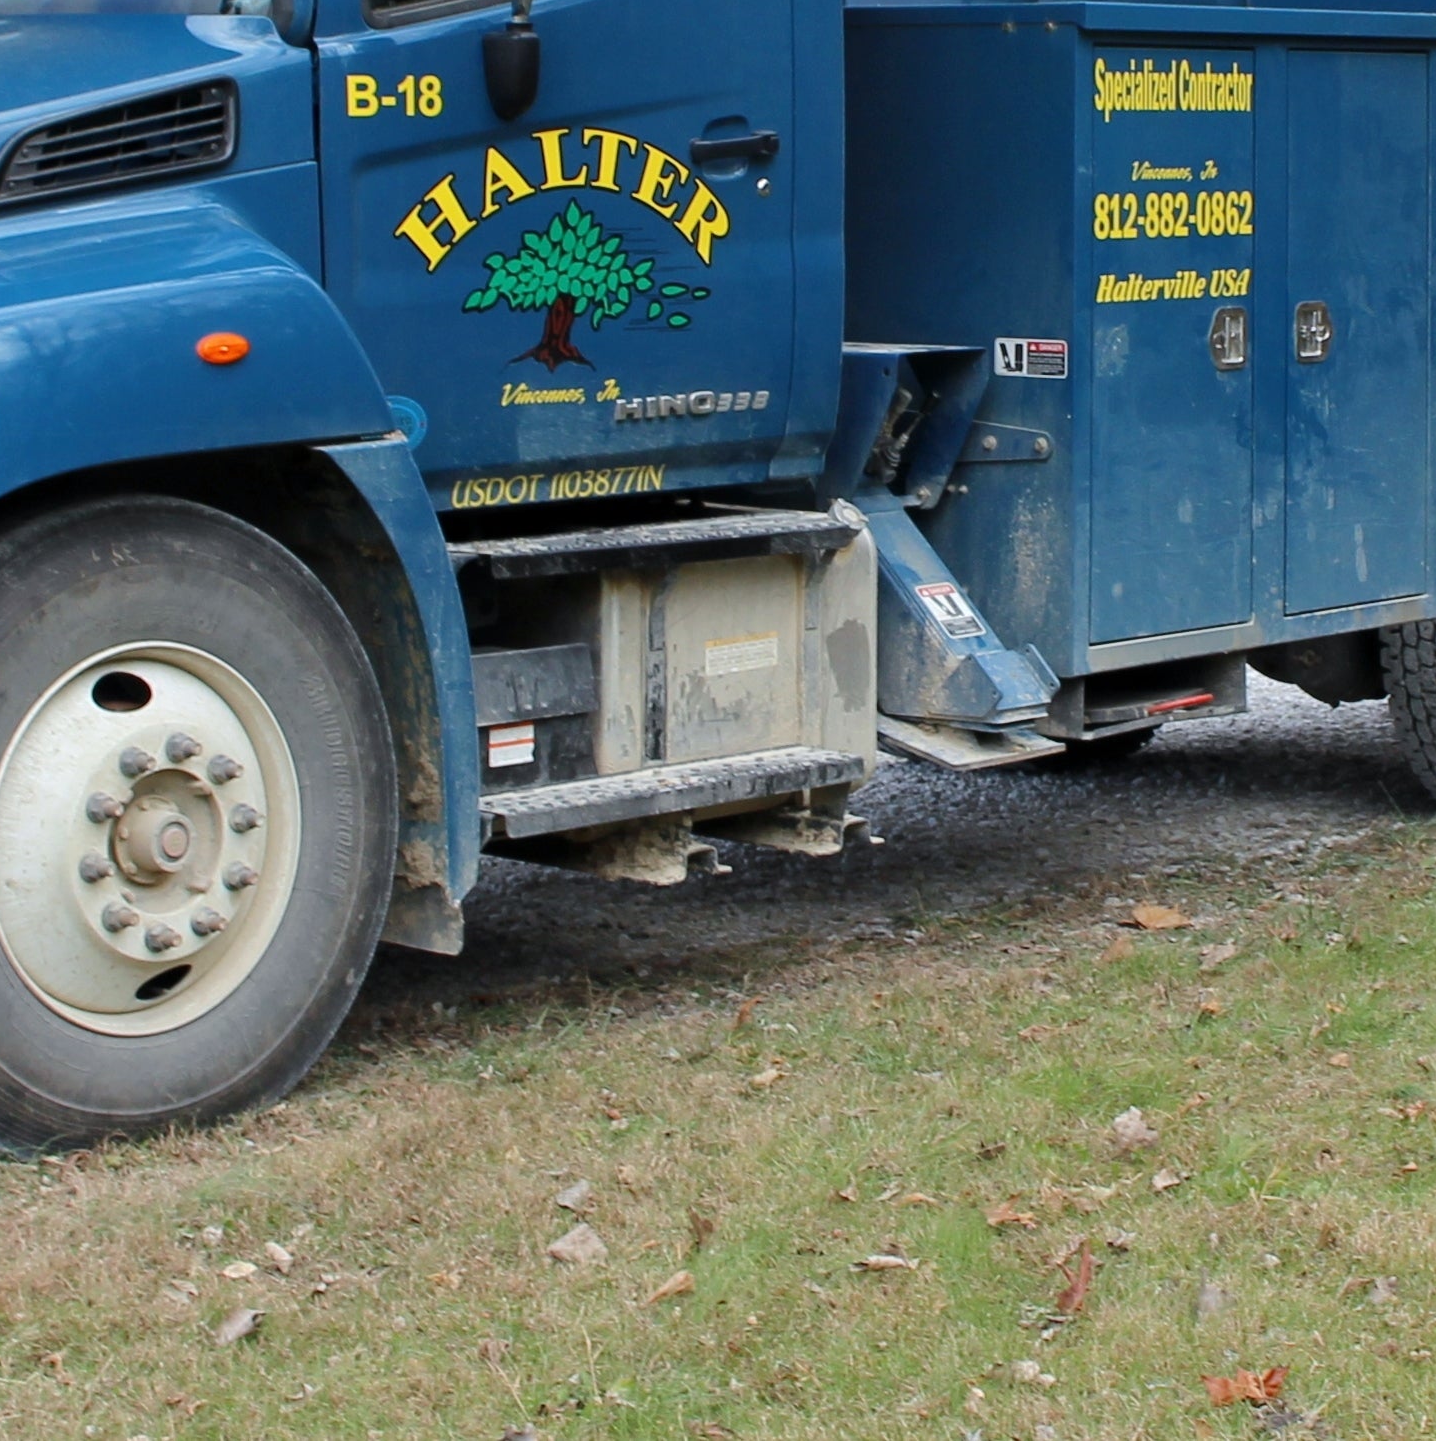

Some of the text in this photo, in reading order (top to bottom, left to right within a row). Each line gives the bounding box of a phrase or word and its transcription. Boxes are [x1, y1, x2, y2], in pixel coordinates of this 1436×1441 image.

[345, 73, 444, 118] B-18
[1093, 57, 1254, 123] Specialized Contractor
[393, 127, 731, 273] HALTER
[1093, 190, 1254, 241] 812-882-0862
[1095, 268, 1252, 304] Halterville USA
[451, 473, 544, 509] USDOT
